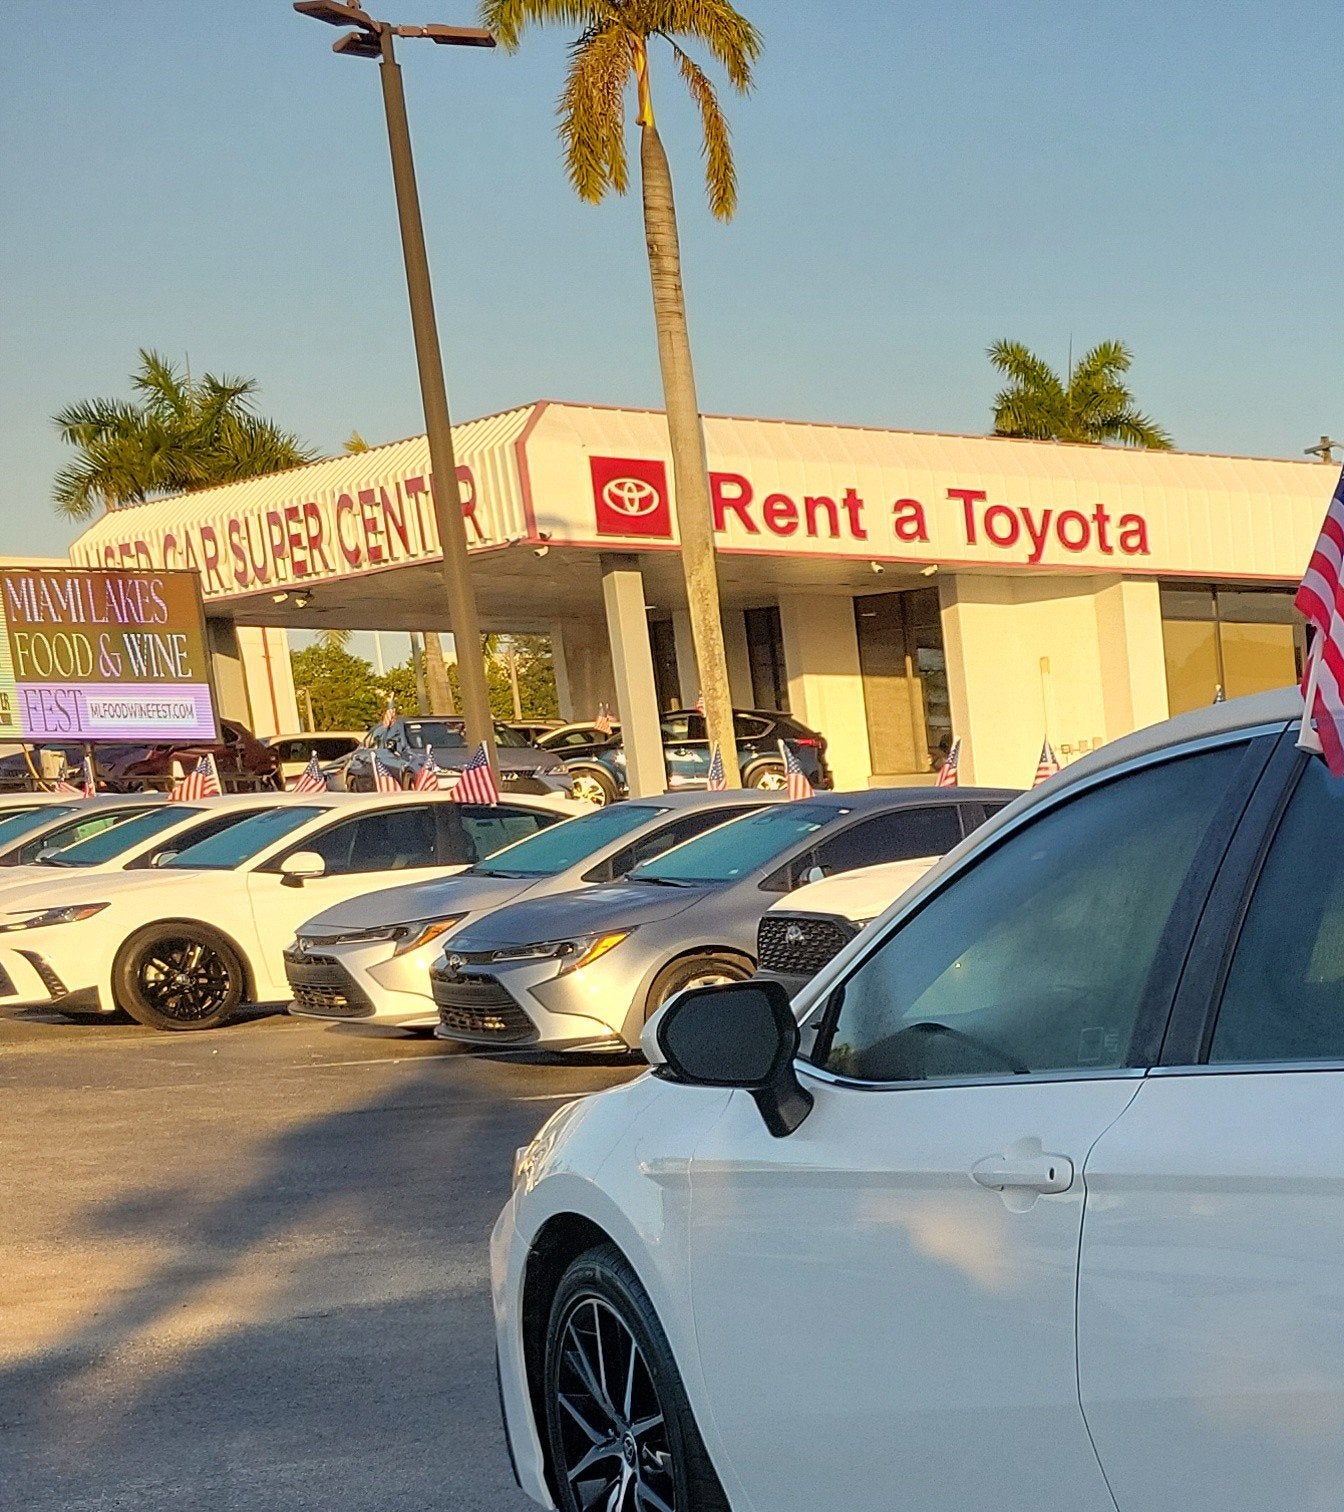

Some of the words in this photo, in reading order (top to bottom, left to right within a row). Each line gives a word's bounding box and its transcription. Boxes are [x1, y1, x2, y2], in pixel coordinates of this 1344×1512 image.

[228, 502, 331, 587] SUPER
[337, 464, 484, 566] CENTR
[709, 472, 868, 541] Rent
[892, 498, 930, 543] a
[946, 488, 1152, 564] Toyota
[5, 578, 86, 623] MIAMI
[86, 579, 168, 624] LAKES
[14, 632, 93, 677] FOOD
[122, 633, 193, 678] WINE
[23, 688, 83, 732] FEST
[90, 702, 195, 719] MLFOODWINEFEST.COM
